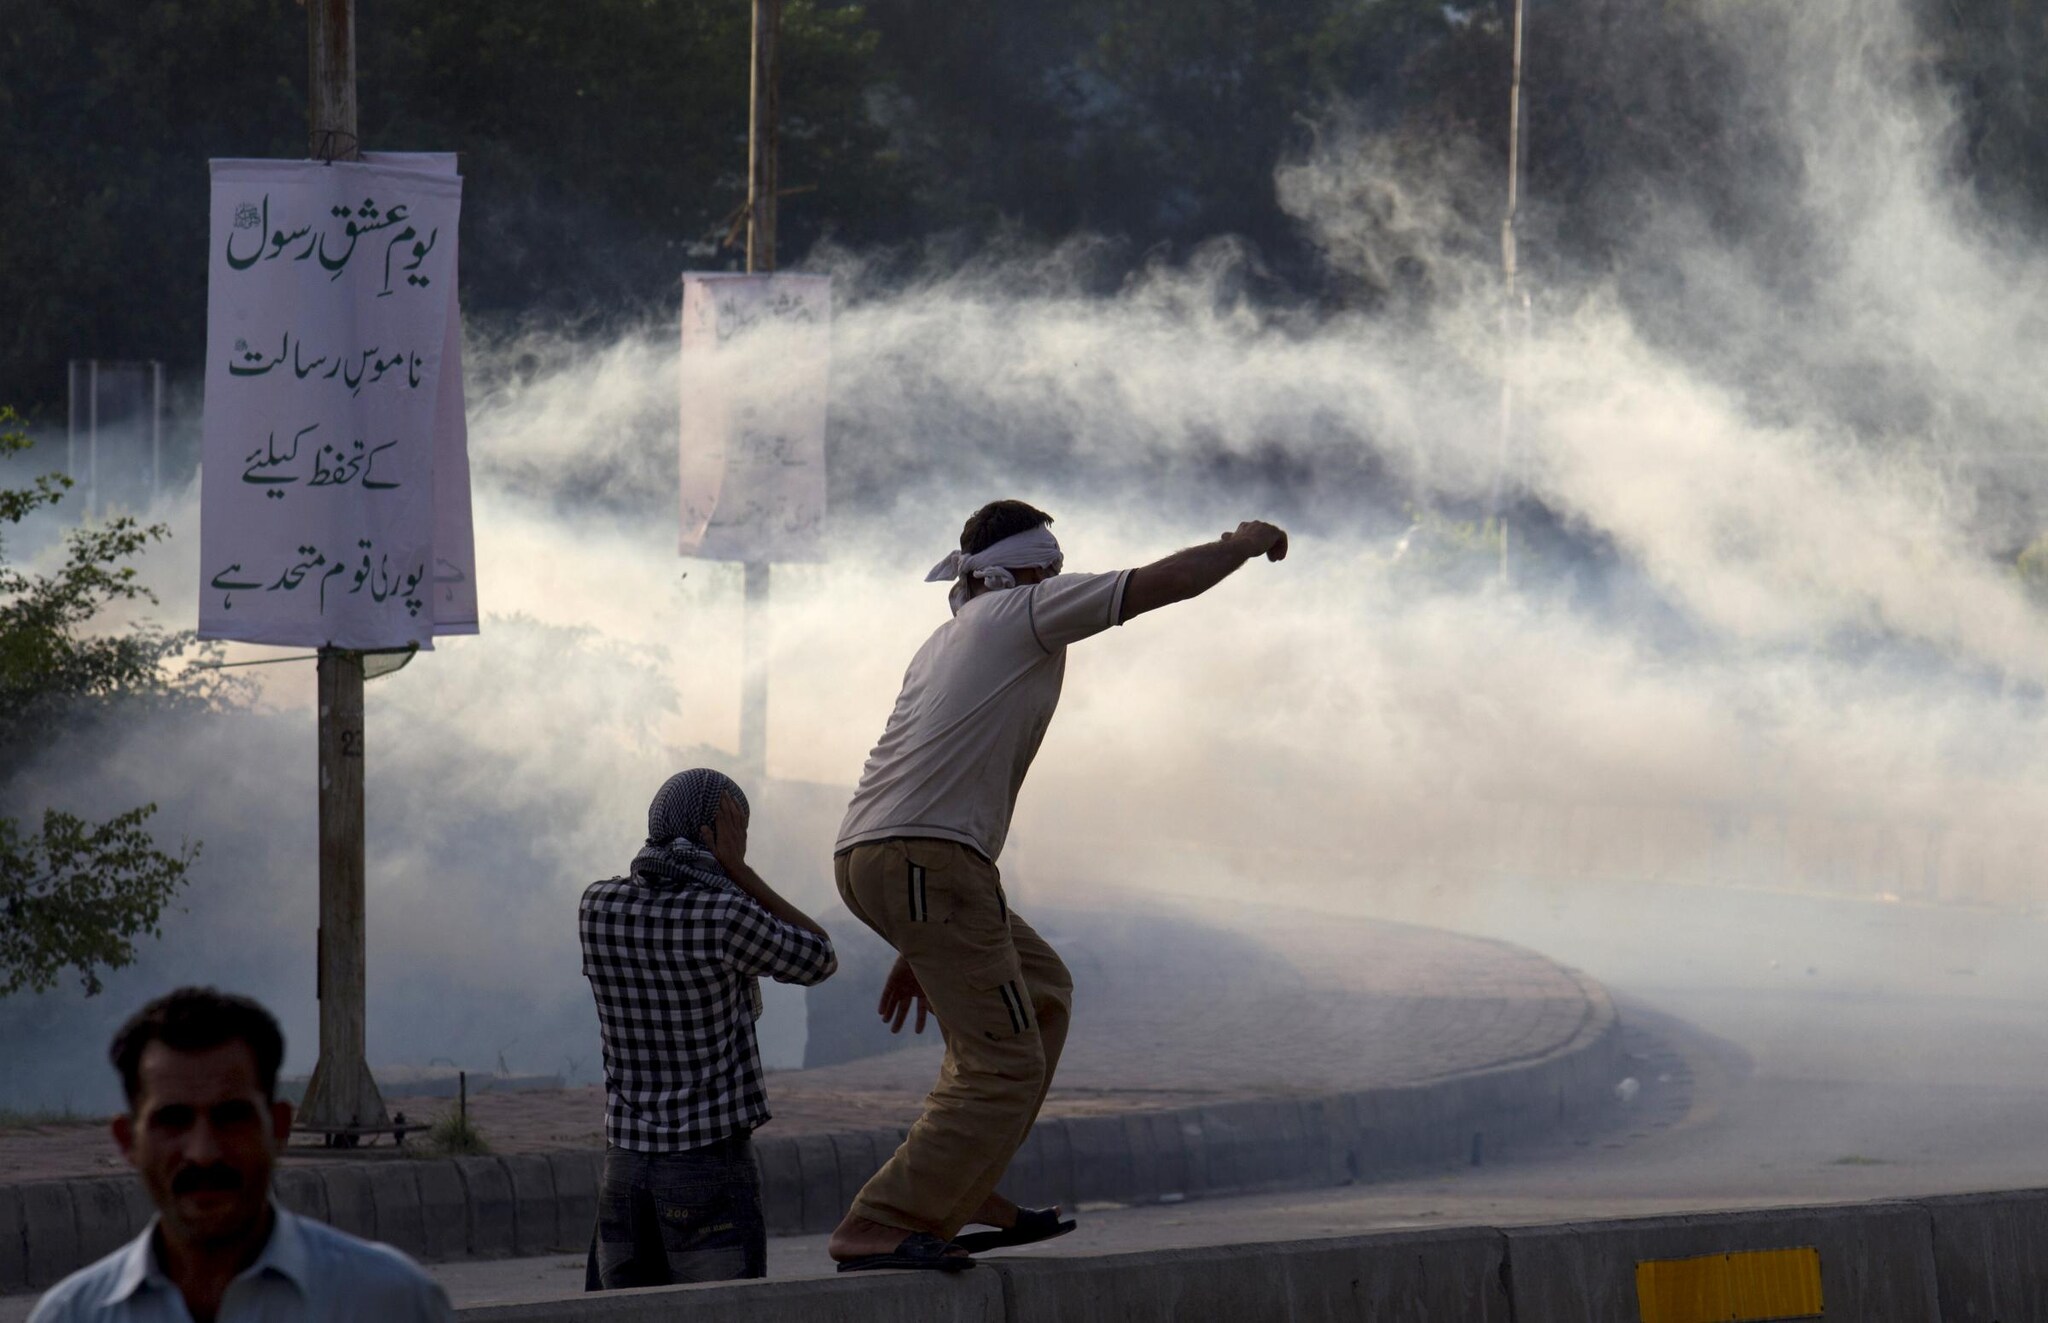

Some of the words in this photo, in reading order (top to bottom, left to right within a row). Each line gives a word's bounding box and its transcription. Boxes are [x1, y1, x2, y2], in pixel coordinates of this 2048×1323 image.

[227, 194, 317, 271] رسول
[229, 332, 341, 379] رسالت
[307, 440, 365, 487] تحفظ
[362, 440, 401, 490] کے
[211, 564, 263, 610] ہے
[267, 545, 326, 591] متحد
[321, 539, 372, 614] قوم
[371, 554, 425, 617] پوری
